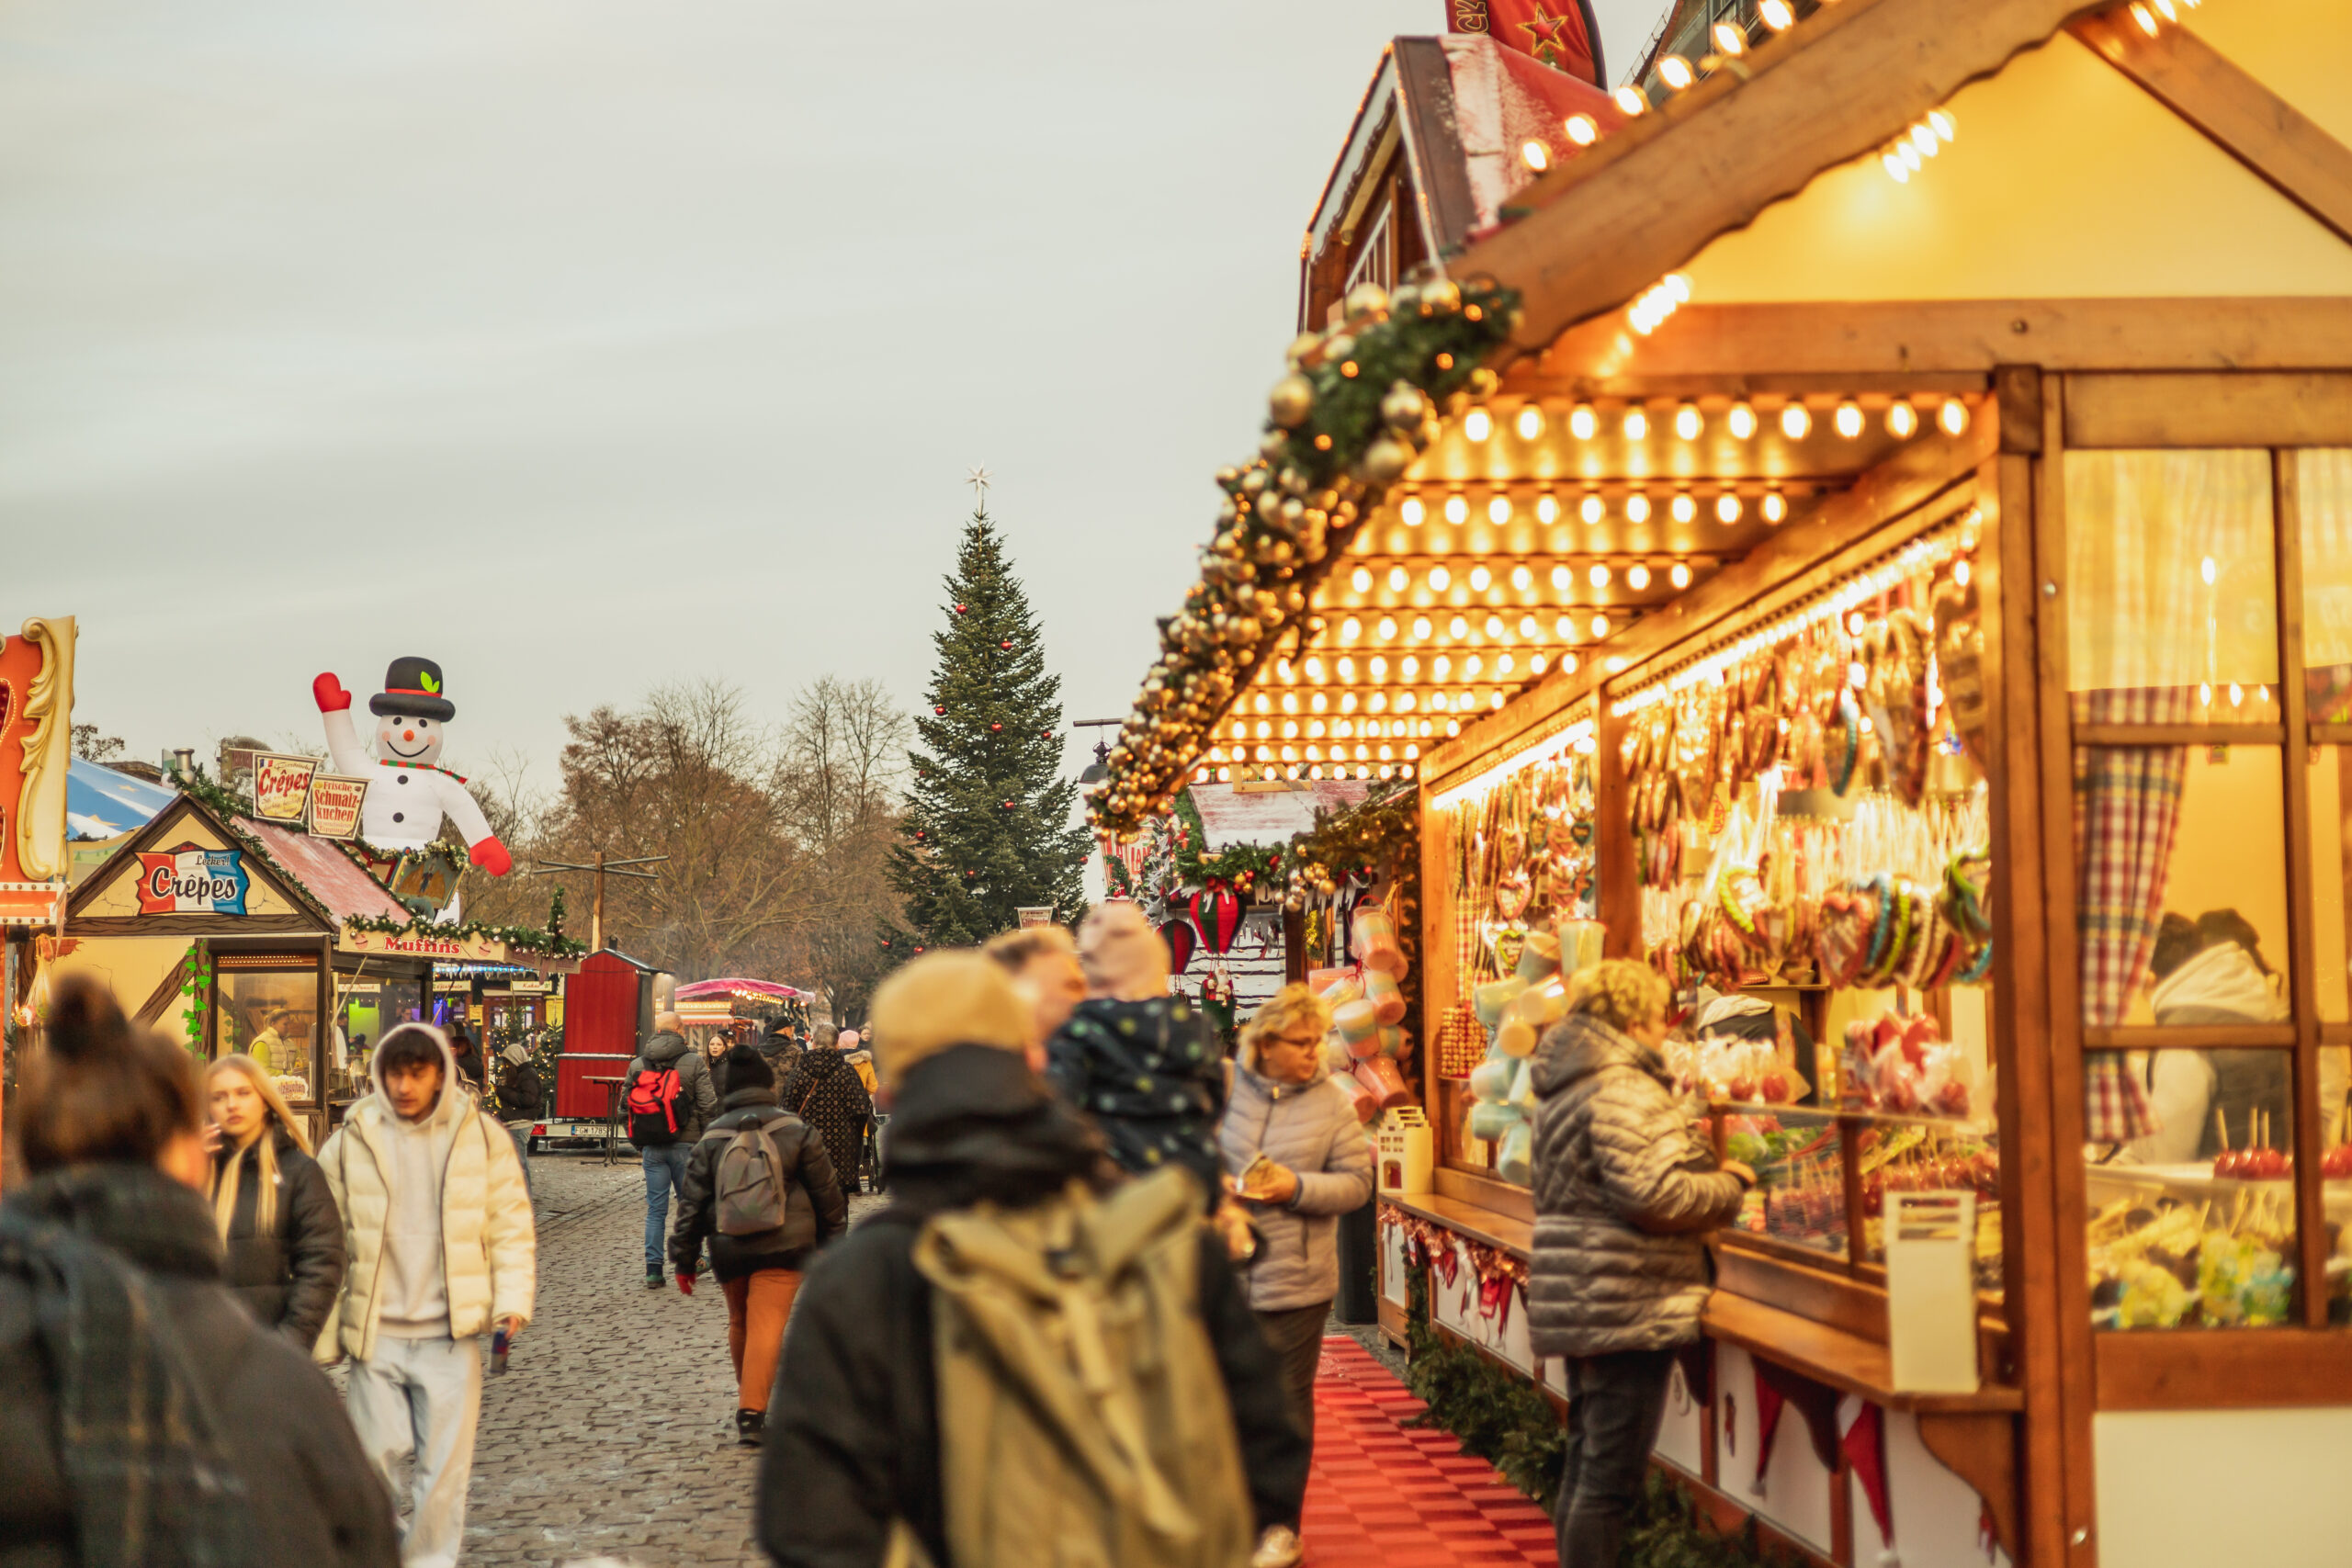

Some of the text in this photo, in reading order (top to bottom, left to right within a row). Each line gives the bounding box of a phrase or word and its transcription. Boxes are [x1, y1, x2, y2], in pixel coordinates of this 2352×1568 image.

[1455, 0, 1488, 35] CK
[258, 768, 311, 797] Crêpes
[323, 781, 353, 791] Frische
[314, 789, 360, 808] Schmalz-
[316, 805, 355, 822] kuchen
[195, 854, 230, 866] Lecker!
[1131, 845, 1152, 875] LAN
[151, 866, 236, 906] Crêpes
[384, 936, 460, 954] Muffins
